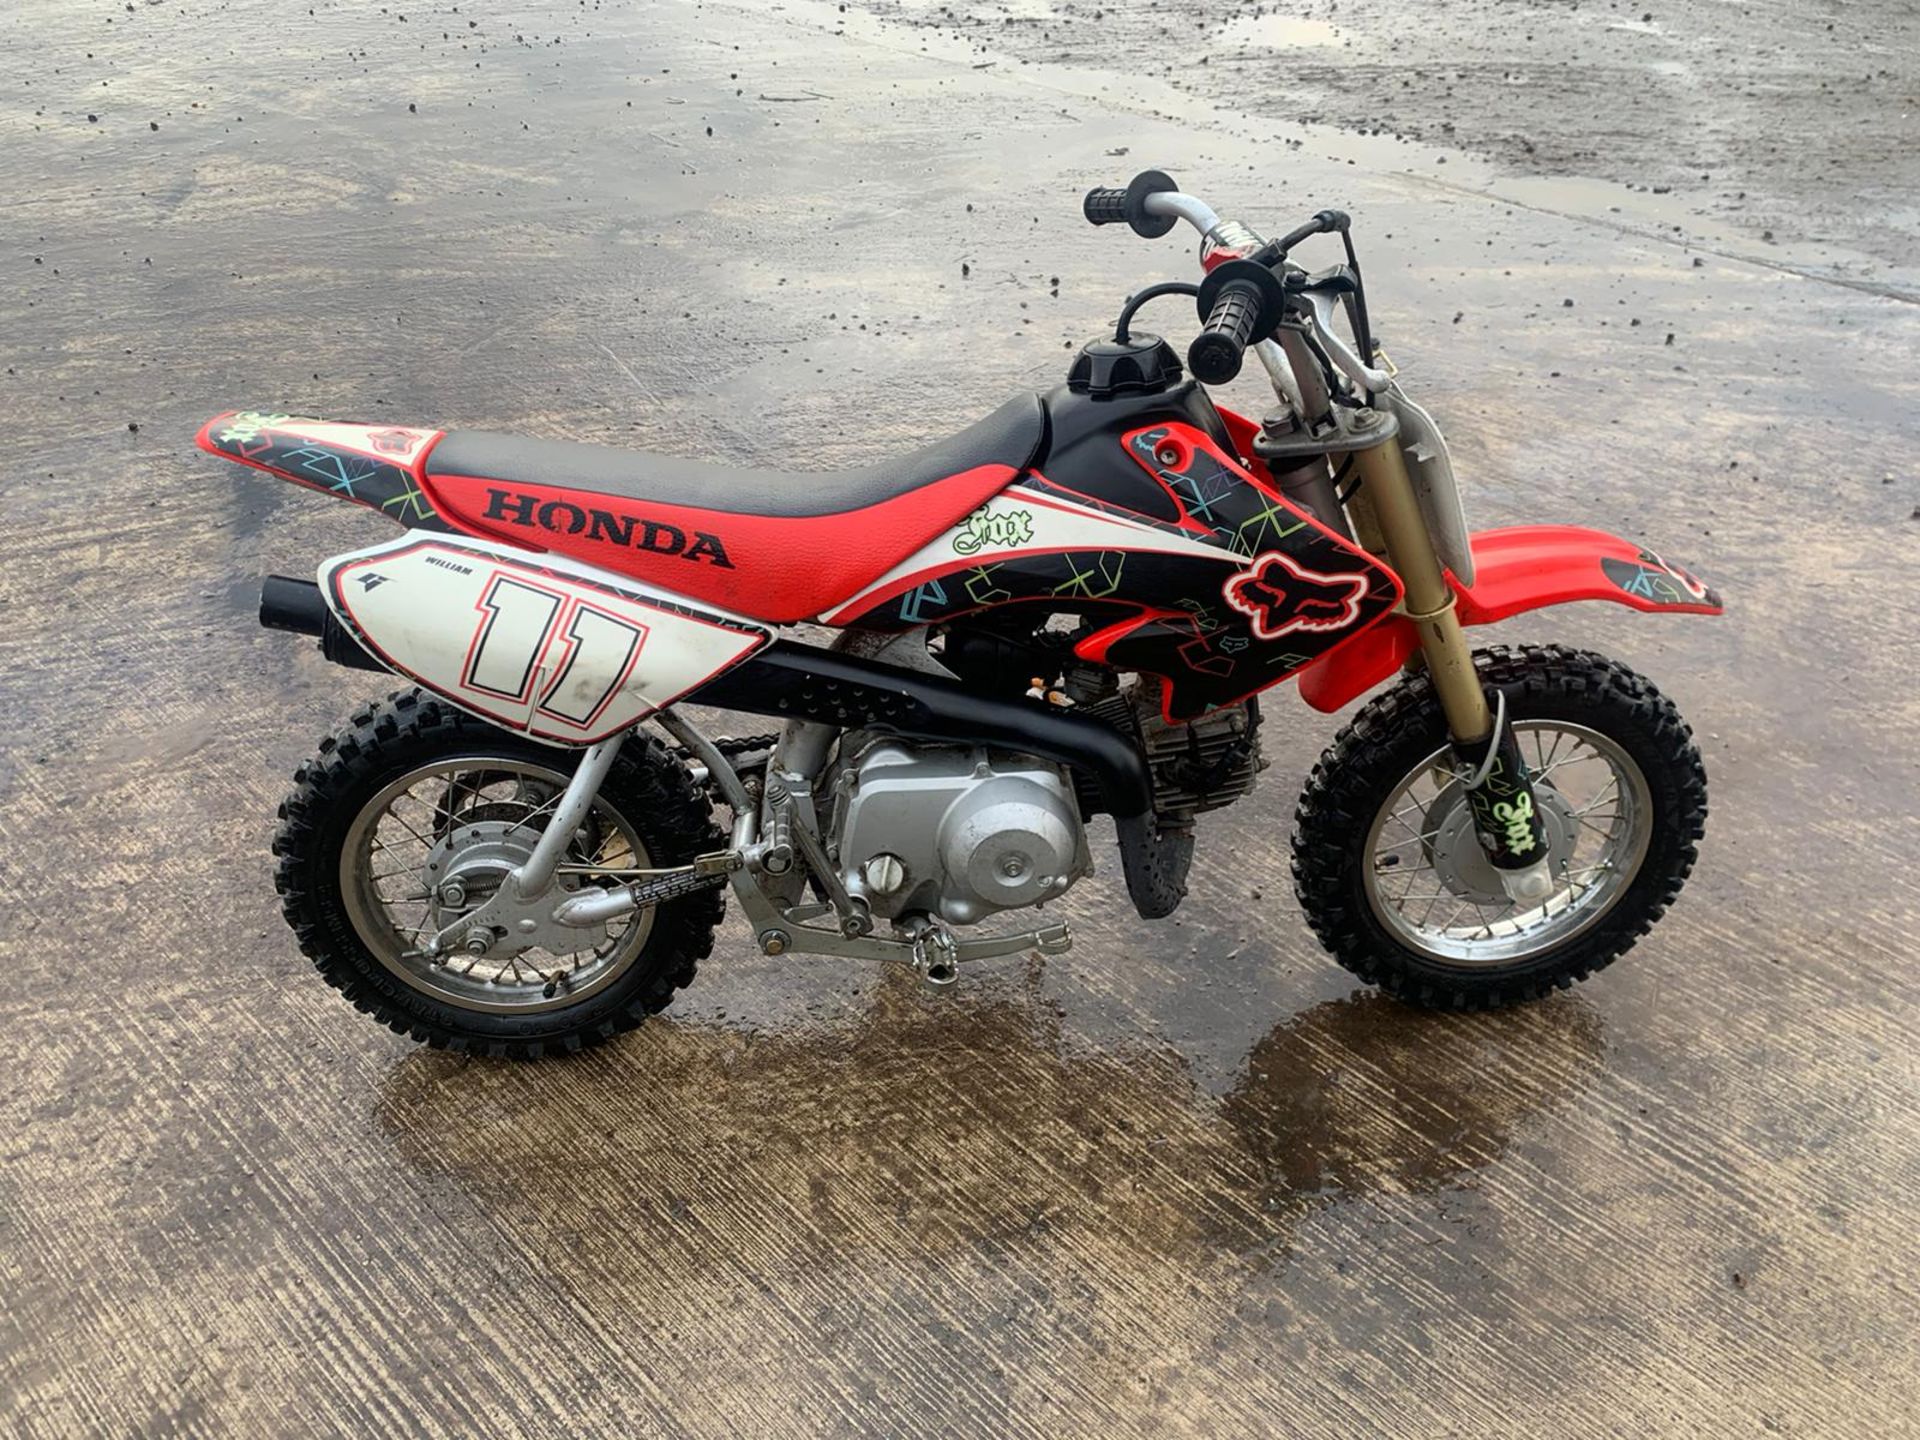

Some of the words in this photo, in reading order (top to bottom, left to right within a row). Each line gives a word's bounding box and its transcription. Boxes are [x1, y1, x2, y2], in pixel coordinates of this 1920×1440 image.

[425, 556, 473, 576] WILLIAM
[482, 488, 736, 570] HONDA
[459, 570, 650, 731] 11
